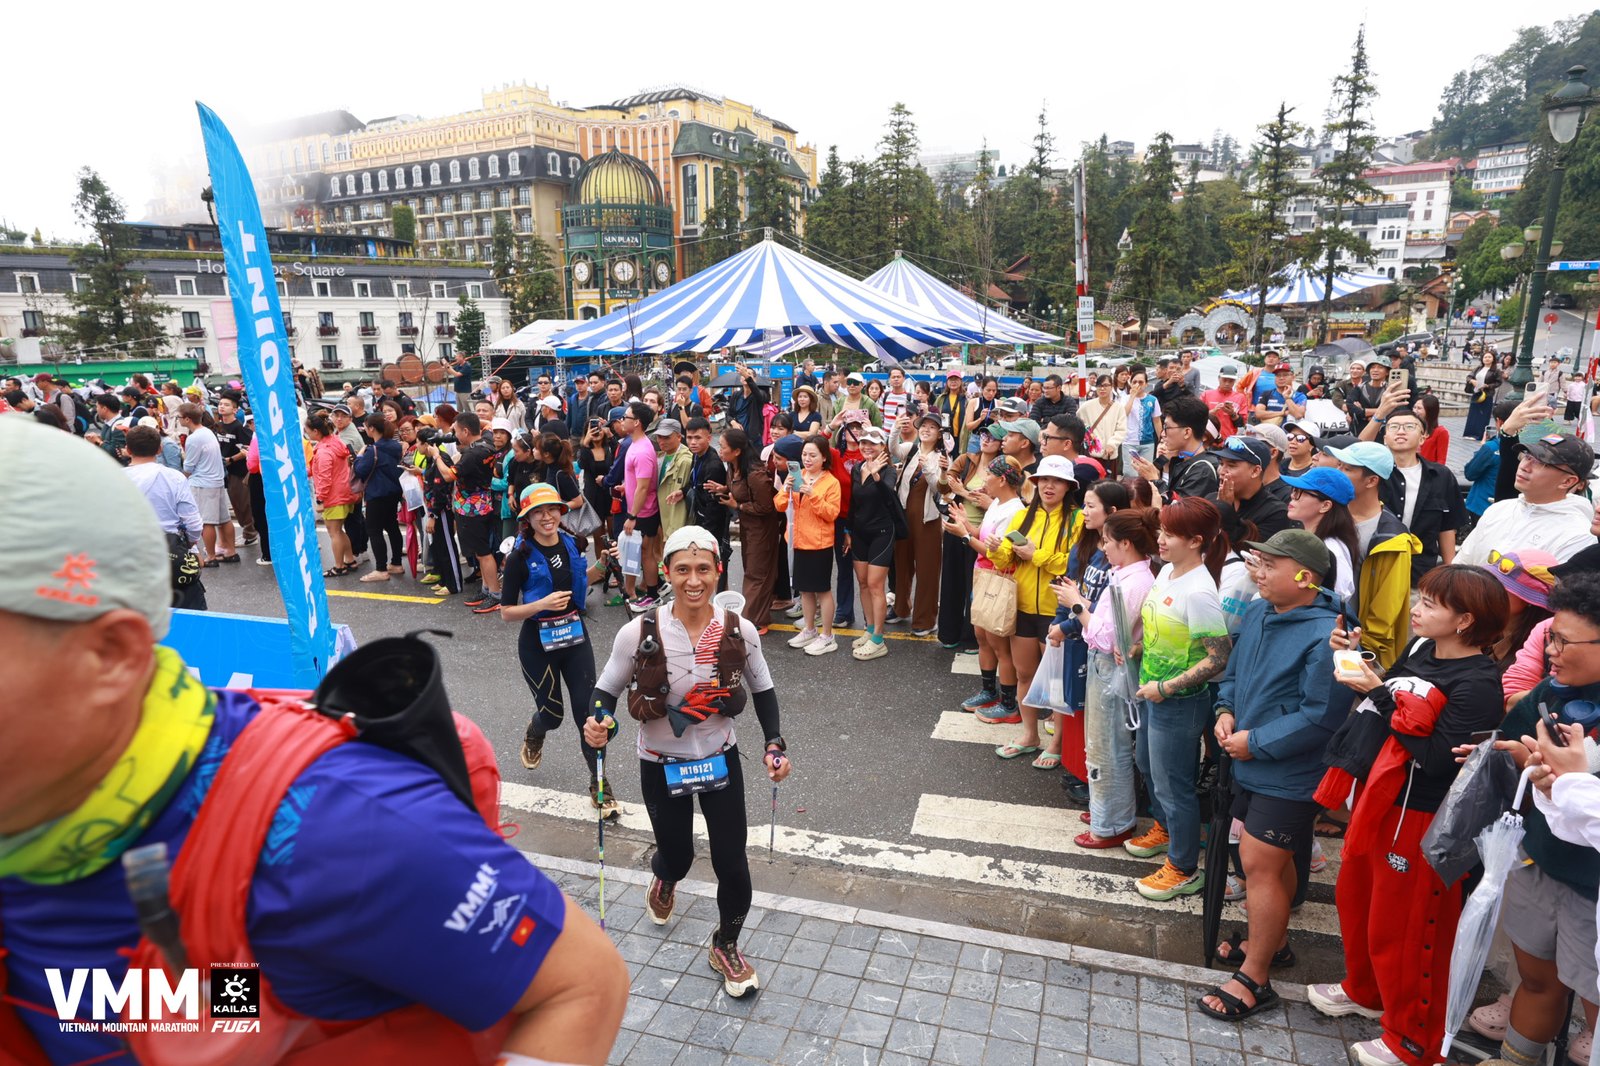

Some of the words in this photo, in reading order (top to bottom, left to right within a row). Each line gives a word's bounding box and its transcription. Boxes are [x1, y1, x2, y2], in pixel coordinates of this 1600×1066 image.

[293, 262, 345, 278] Square
[680, 762, 713, 776] M16121
[444, 869, 497, 932] VMM
